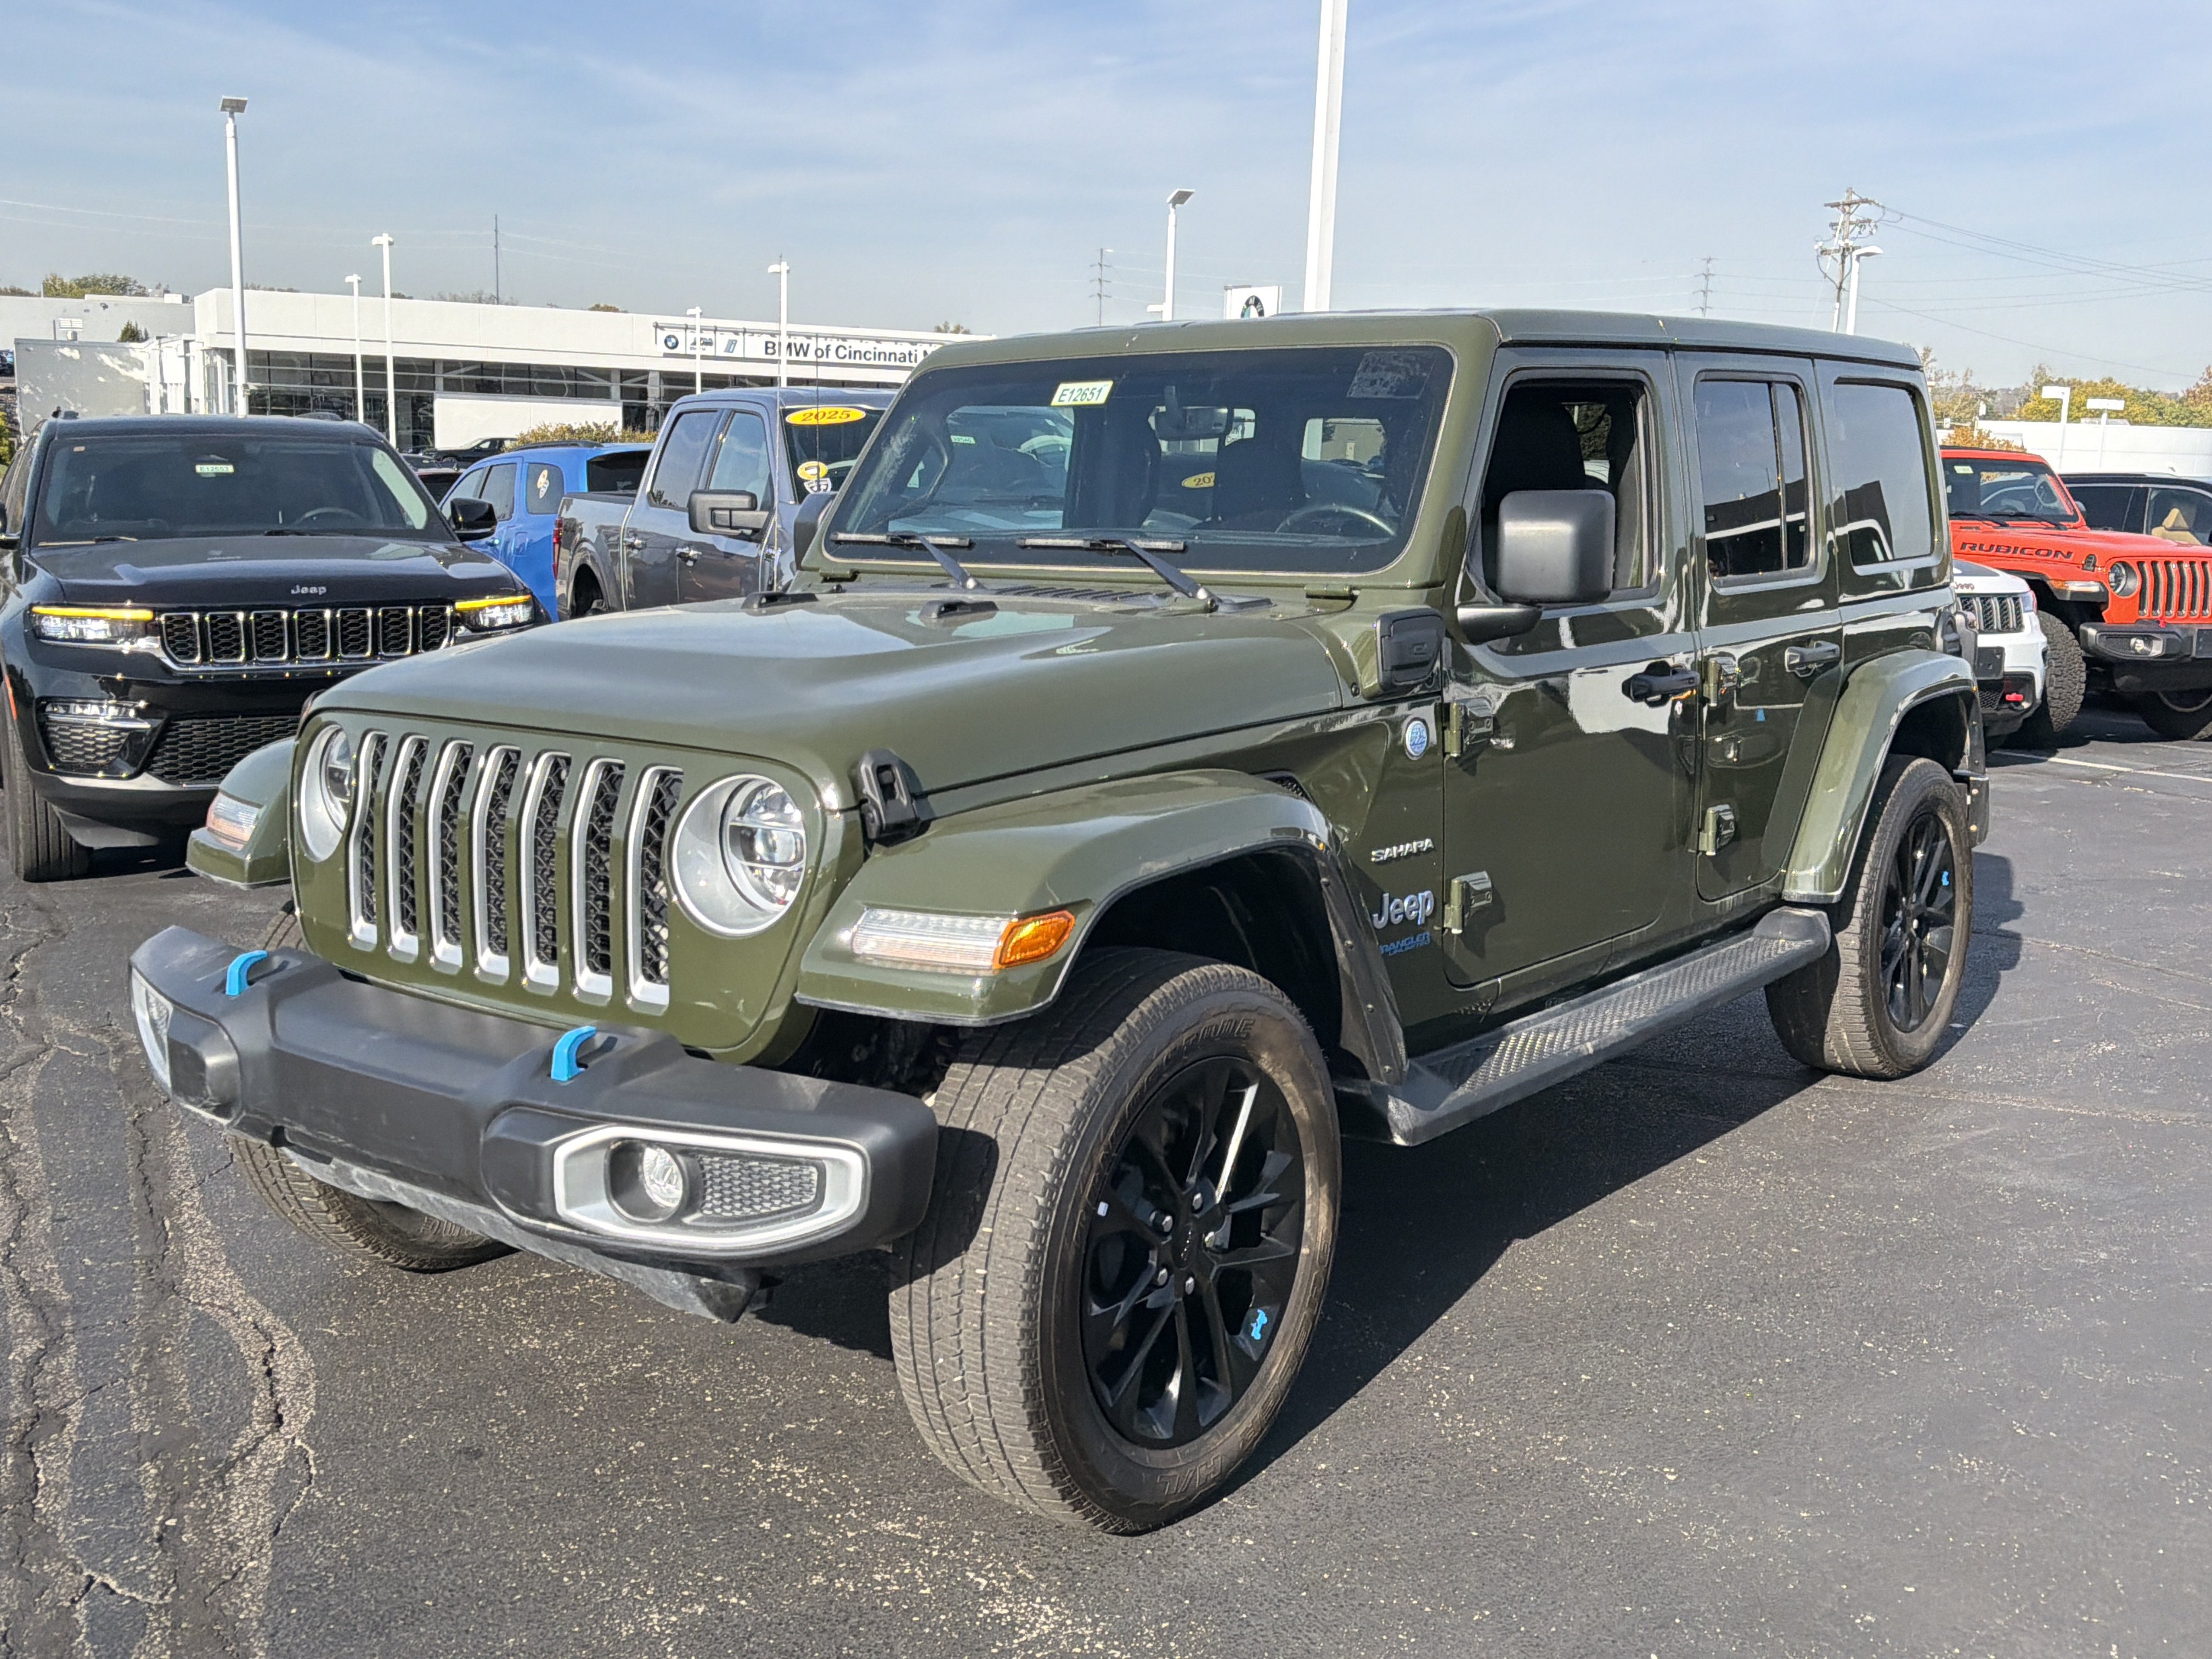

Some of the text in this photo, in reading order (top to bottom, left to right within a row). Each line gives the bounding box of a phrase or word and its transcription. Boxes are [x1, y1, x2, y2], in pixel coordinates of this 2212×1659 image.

[765, 341, 810, 357] BMW
[814, 344, 831, 359] of
[835, 345, 918, 363] Cincinnati
[1058, 386, 1103, 402] E12651
[801, 410, 851, 422] 2025
[1193, 475, 1214, 487] 20
[1960, 542, 2073, 559] RUBICON
[291, 585, 327, 595] Jeep
[1954, 582, 1974, 591] Jeep
[1371, 838, 1435, 862] SAHARA
[1372, 890, 1435, 929] Jeep
